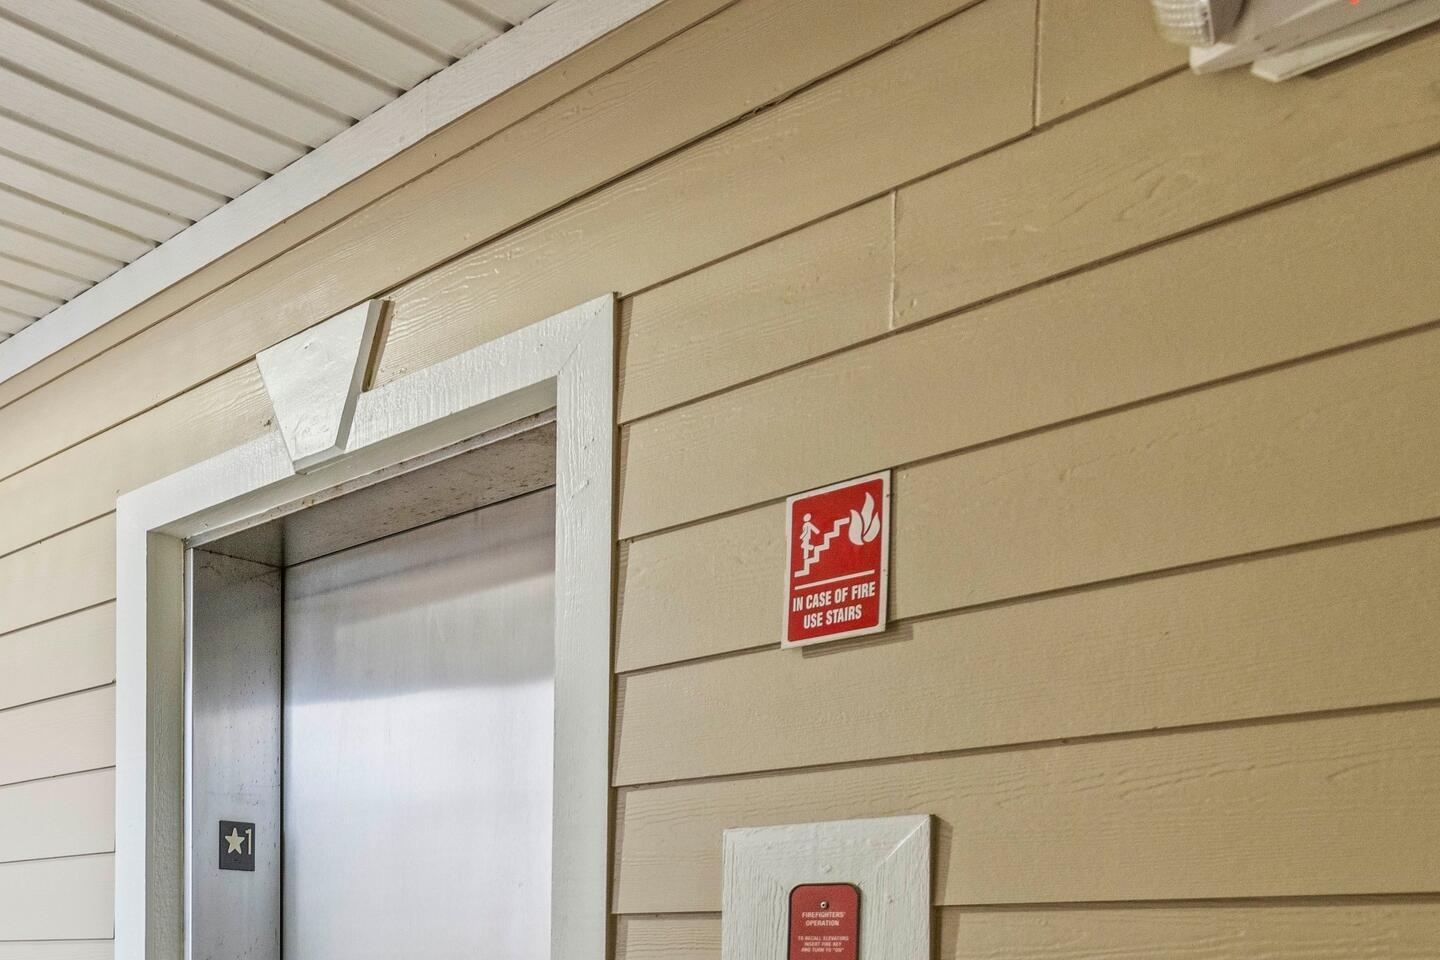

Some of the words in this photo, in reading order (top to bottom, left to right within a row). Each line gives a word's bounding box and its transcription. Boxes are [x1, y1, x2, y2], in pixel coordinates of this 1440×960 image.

[792, 596, 804, 612] IN
[805, 590, 832, 610] CASE
[834, 586, 849, 604] OF
[851, 581, 876, 600] FIRE
[803, 612, 824, 629] USE
[825, 604, 863, 625] STAIRS
[245, 828, 252, 855] 1
